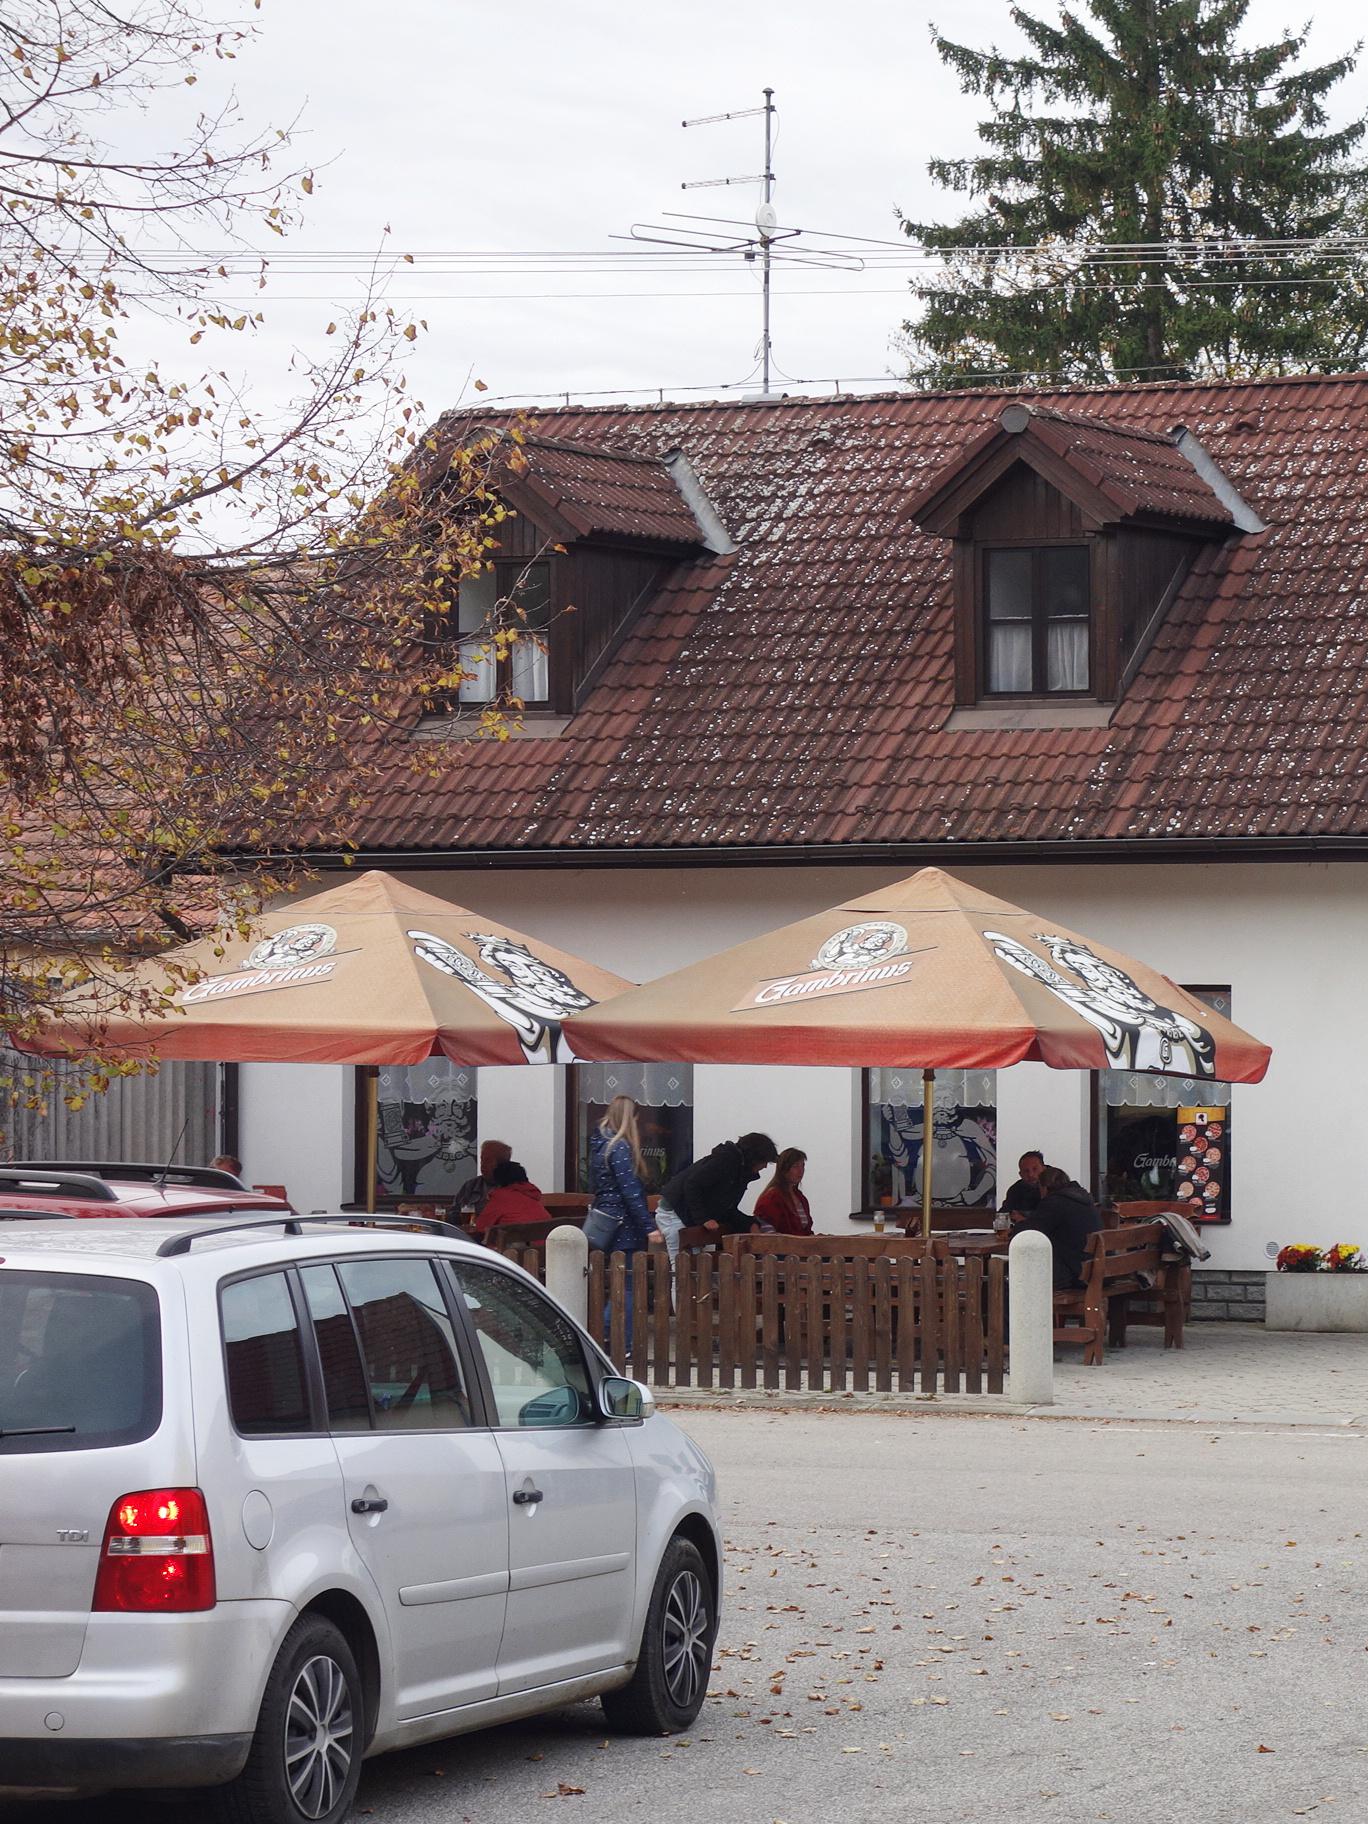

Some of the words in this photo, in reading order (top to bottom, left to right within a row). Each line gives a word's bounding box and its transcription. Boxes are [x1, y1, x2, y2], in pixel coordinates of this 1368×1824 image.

[182, 961, 337, 1002] Gambrinus
[754, 961, 913, 1003] Gambrinus
[640, 1147, 666, 1157] rinus
[1133, 1152, 1177, 1168] Gambr
[56, 1529, 89, 1543] TDI
